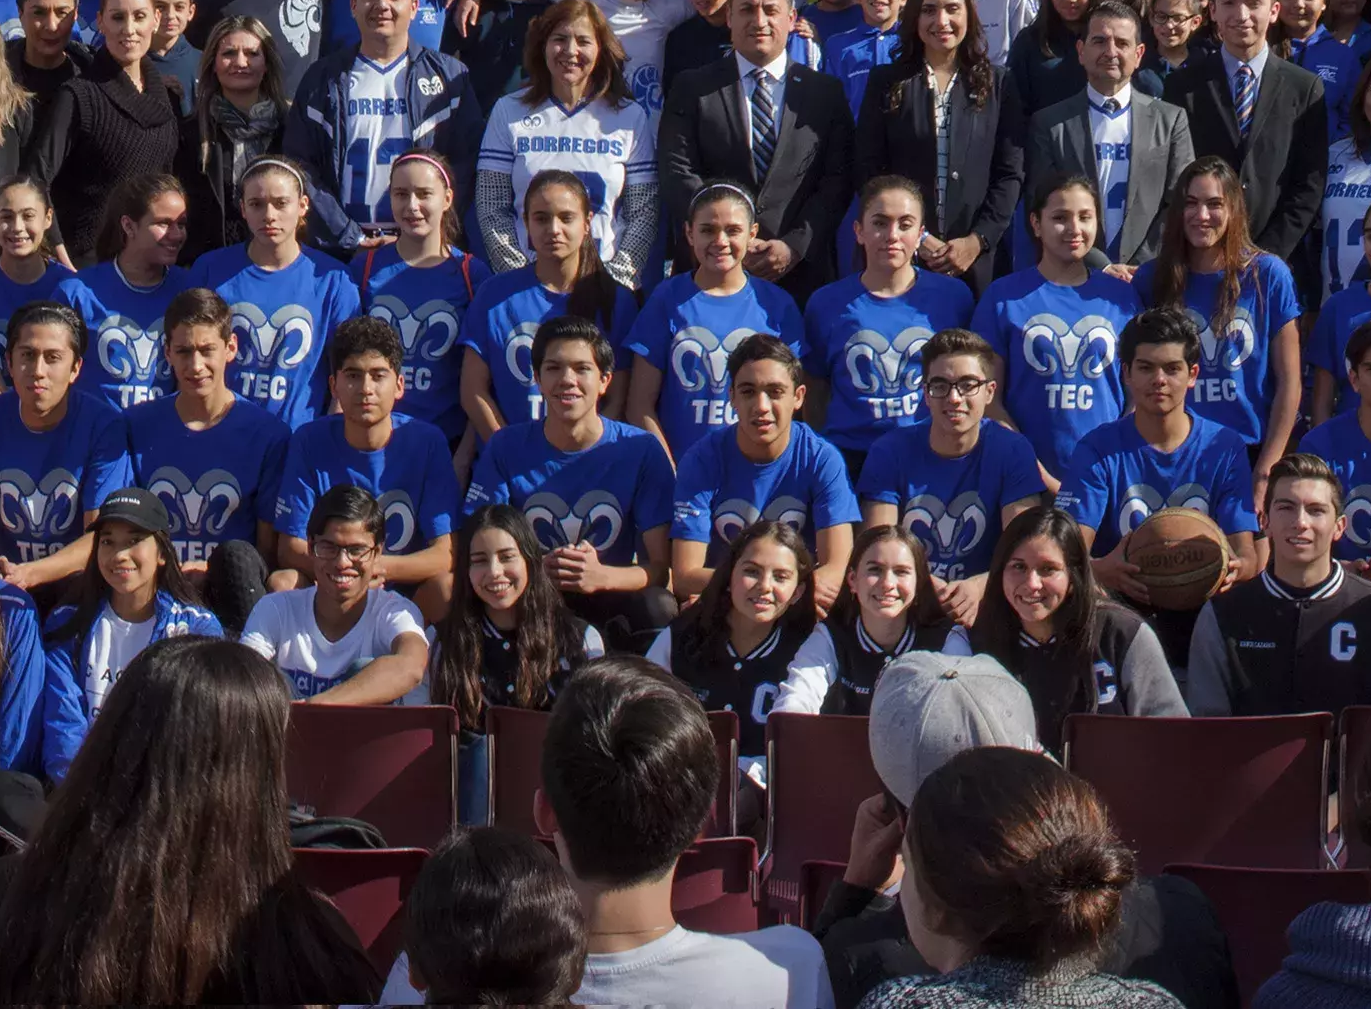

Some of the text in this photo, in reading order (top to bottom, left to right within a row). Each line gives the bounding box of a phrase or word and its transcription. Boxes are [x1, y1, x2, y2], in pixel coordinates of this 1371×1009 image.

[516, 135, 625, 158] BORREGOS
[240, 371, 287, 401] TEC
[1044, 383, 1094, 410] TEC
[1194, 377, 1237, 403] TEC
[867, 391, 919, 419] TEC
[1330, 621, 1358, 661] C
[1093, 661, 1117, 705] C
[751, 682, 780, 724] C
